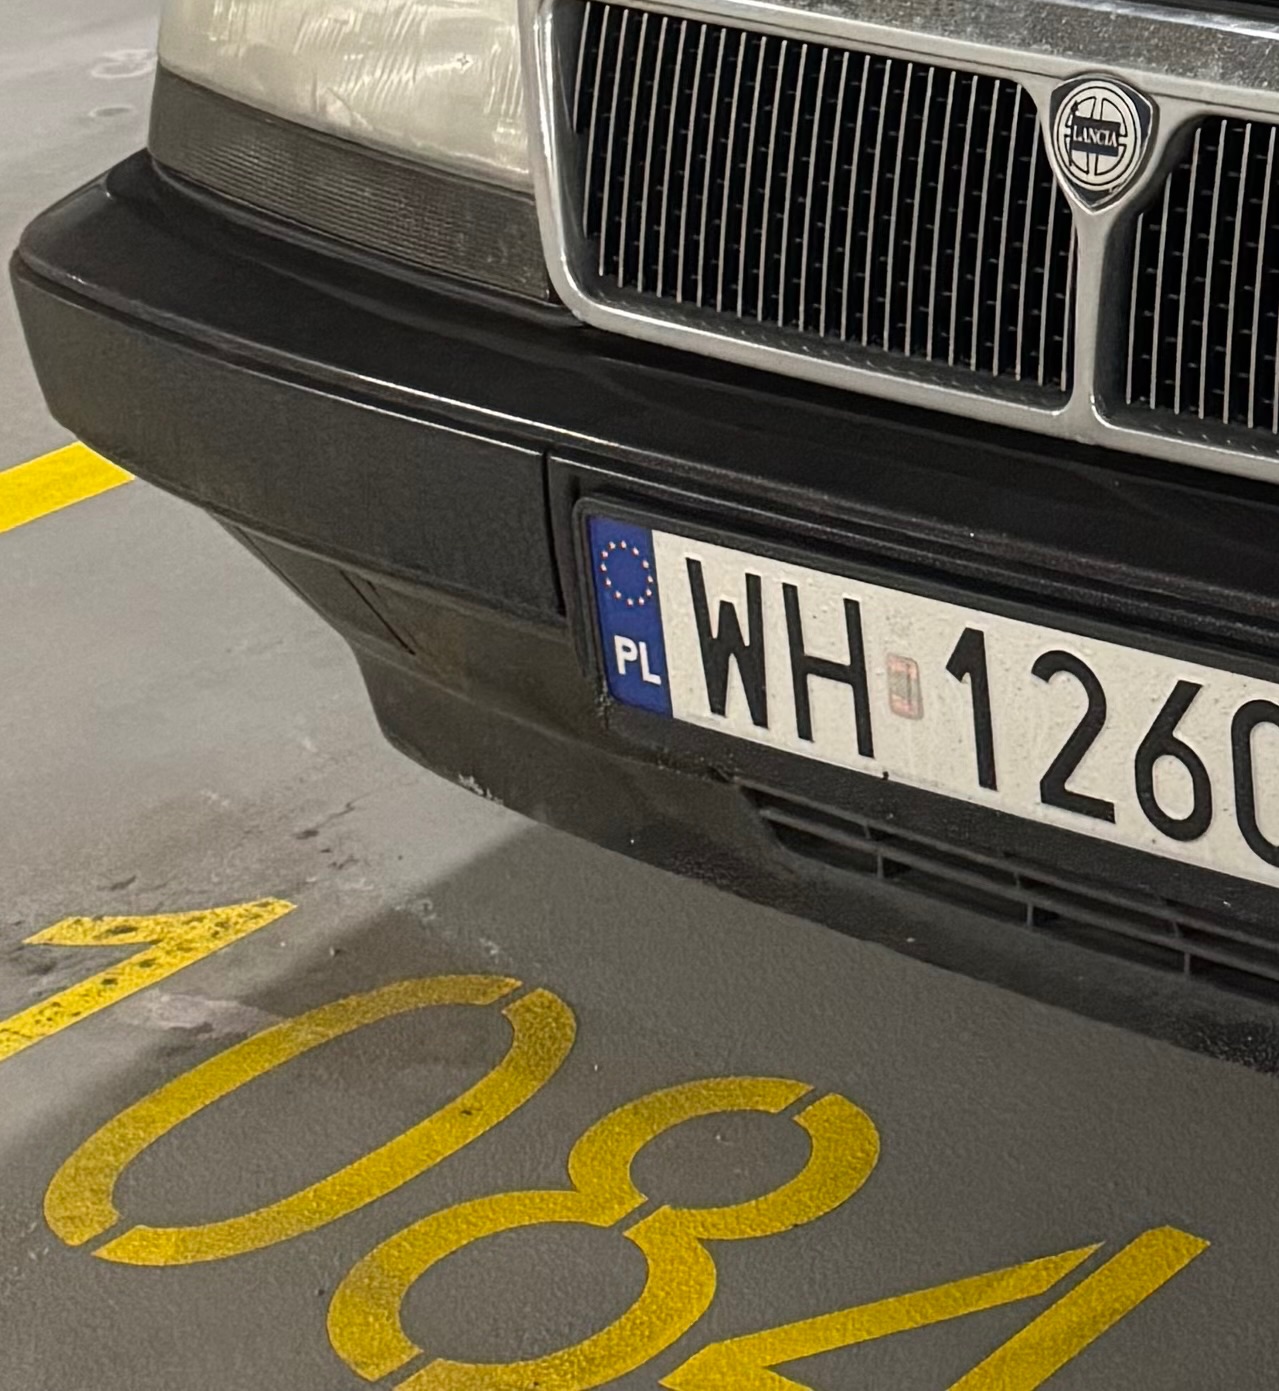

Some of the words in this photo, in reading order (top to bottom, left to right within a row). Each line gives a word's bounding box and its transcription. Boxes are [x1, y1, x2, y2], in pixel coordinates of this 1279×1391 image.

[1073, 125, 1117, 148] LANCIA
[614, 635, 662, 686] PL
[686, 557, 874, 758] WH
